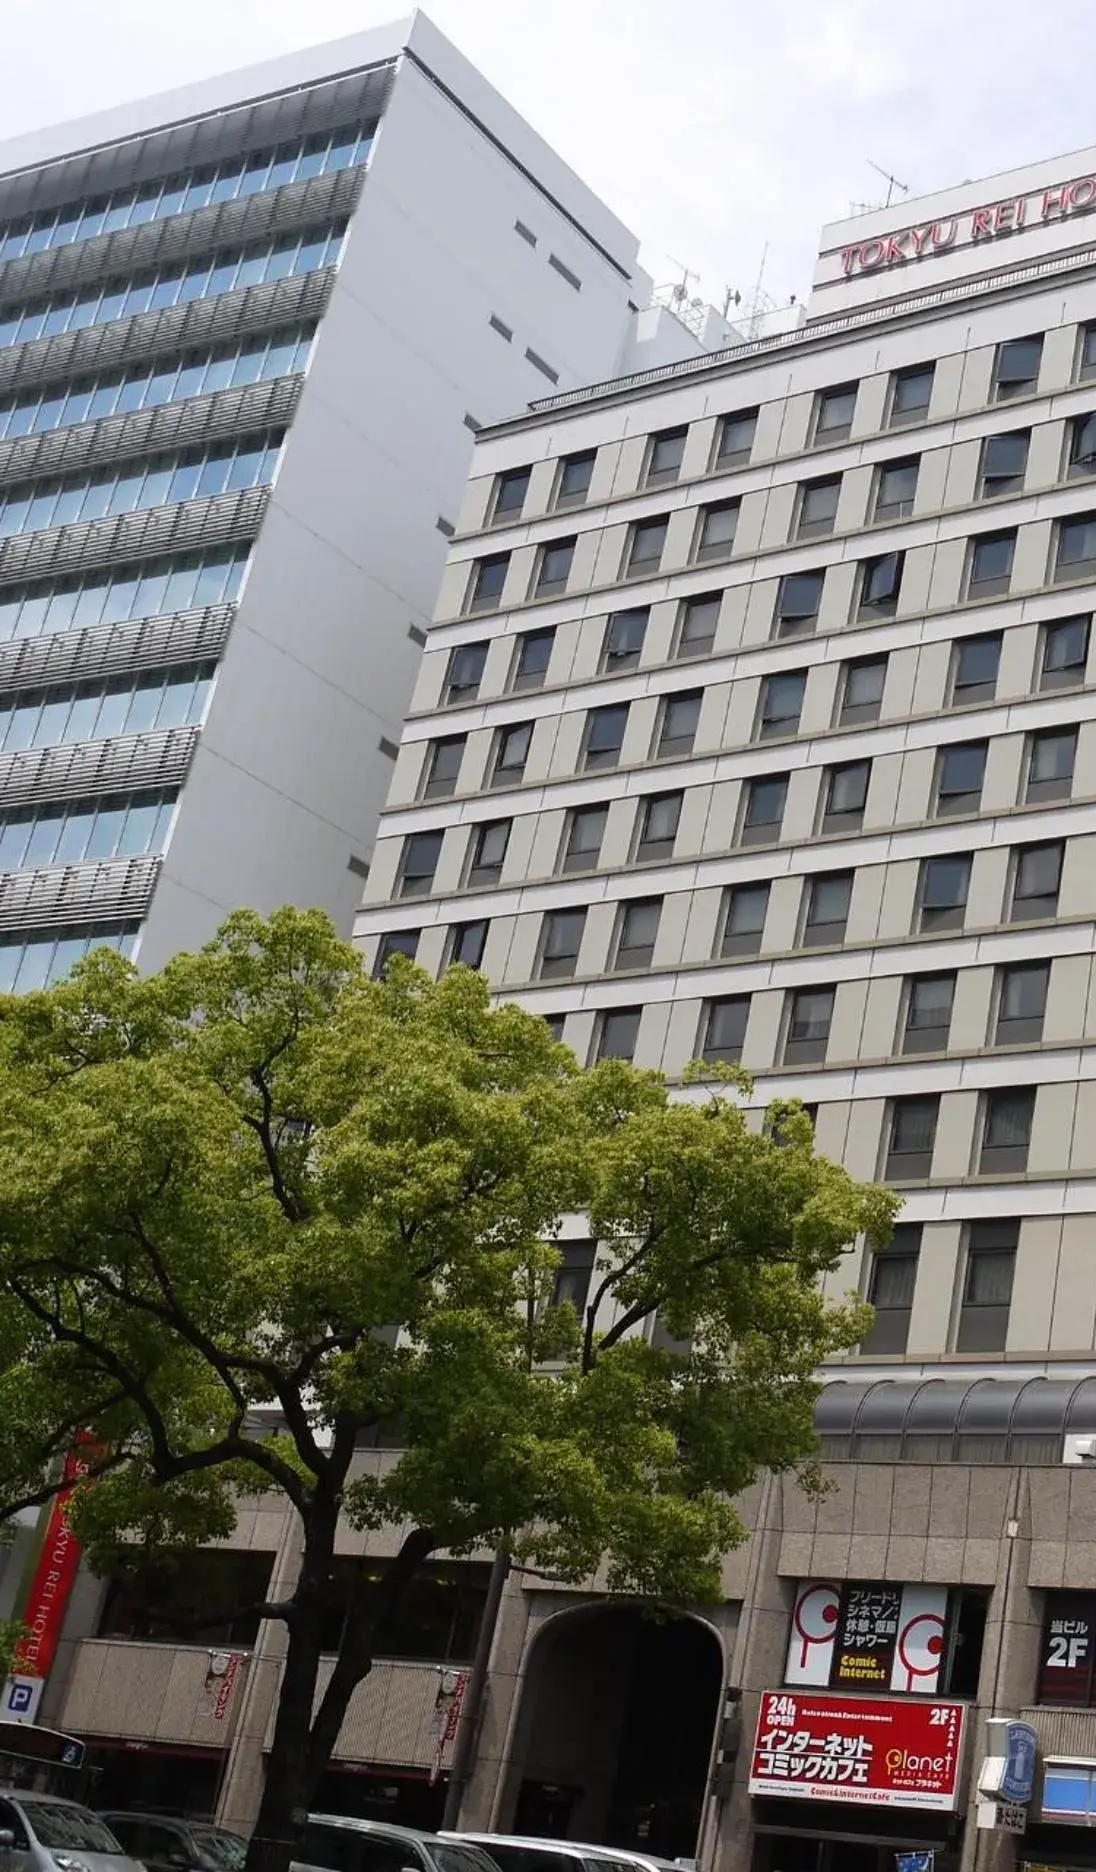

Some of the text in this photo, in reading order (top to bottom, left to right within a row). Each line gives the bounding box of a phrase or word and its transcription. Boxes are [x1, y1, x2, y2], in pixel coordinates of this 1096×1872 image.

[842, 219, 957, 275] TOKYU
[970, 199, 1026, 239] REI
[43, 1569, 61, 1599] REI
[1051, 1619, 1088, 1634] 当ビル
[843, 1633, 888, 1647] シャワー
[840, 1655, 877, 1668] Comic
[1046, 1636, 1088, 1668] 2F
[839, 1666, 886, 1679] Internet
[10, 1688, 31, 1710] P
[768, 1696, 796, 1716] 24h
[766, 1714, 795, 1727] OPEN
[929, 1708, 949, 1725] 2F
[760, 1728, 873, 1758] インターネット
[757, 1753, 869, 1783] コミックカフェ
